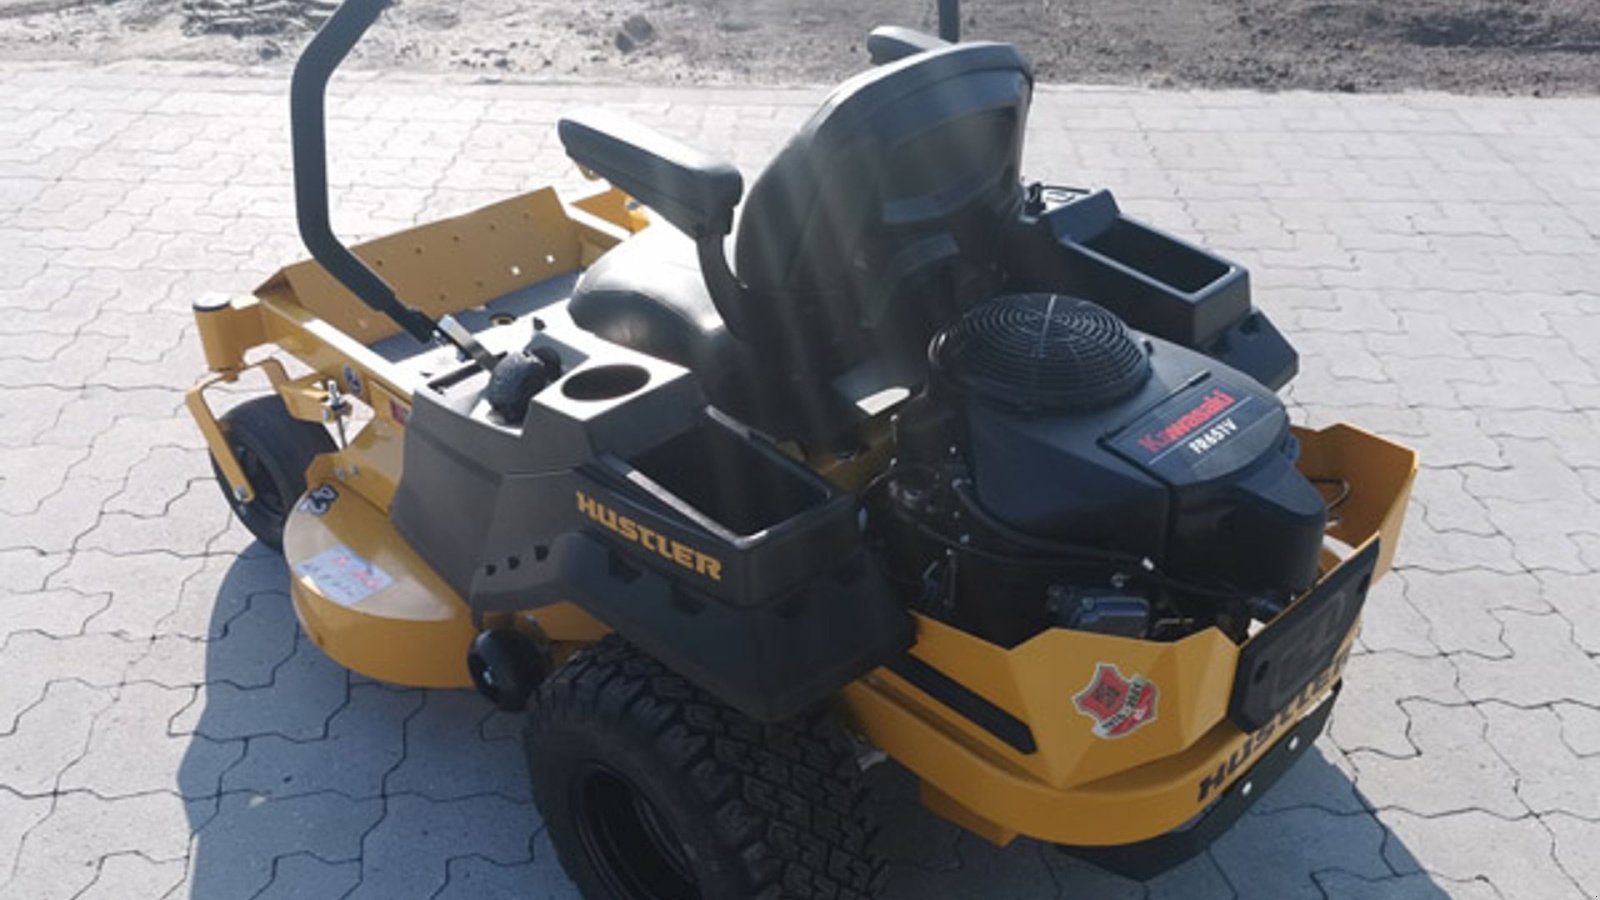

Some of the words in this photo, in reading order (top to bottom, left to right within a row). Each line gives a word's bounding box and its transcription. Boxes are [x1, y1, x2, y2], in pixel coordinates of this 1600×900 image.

[1137, 388, 1236, 452] Kawasaki
[1188, 418, 1238, 454] FR651V
[576, 490, 722, 581] HUSTLER
